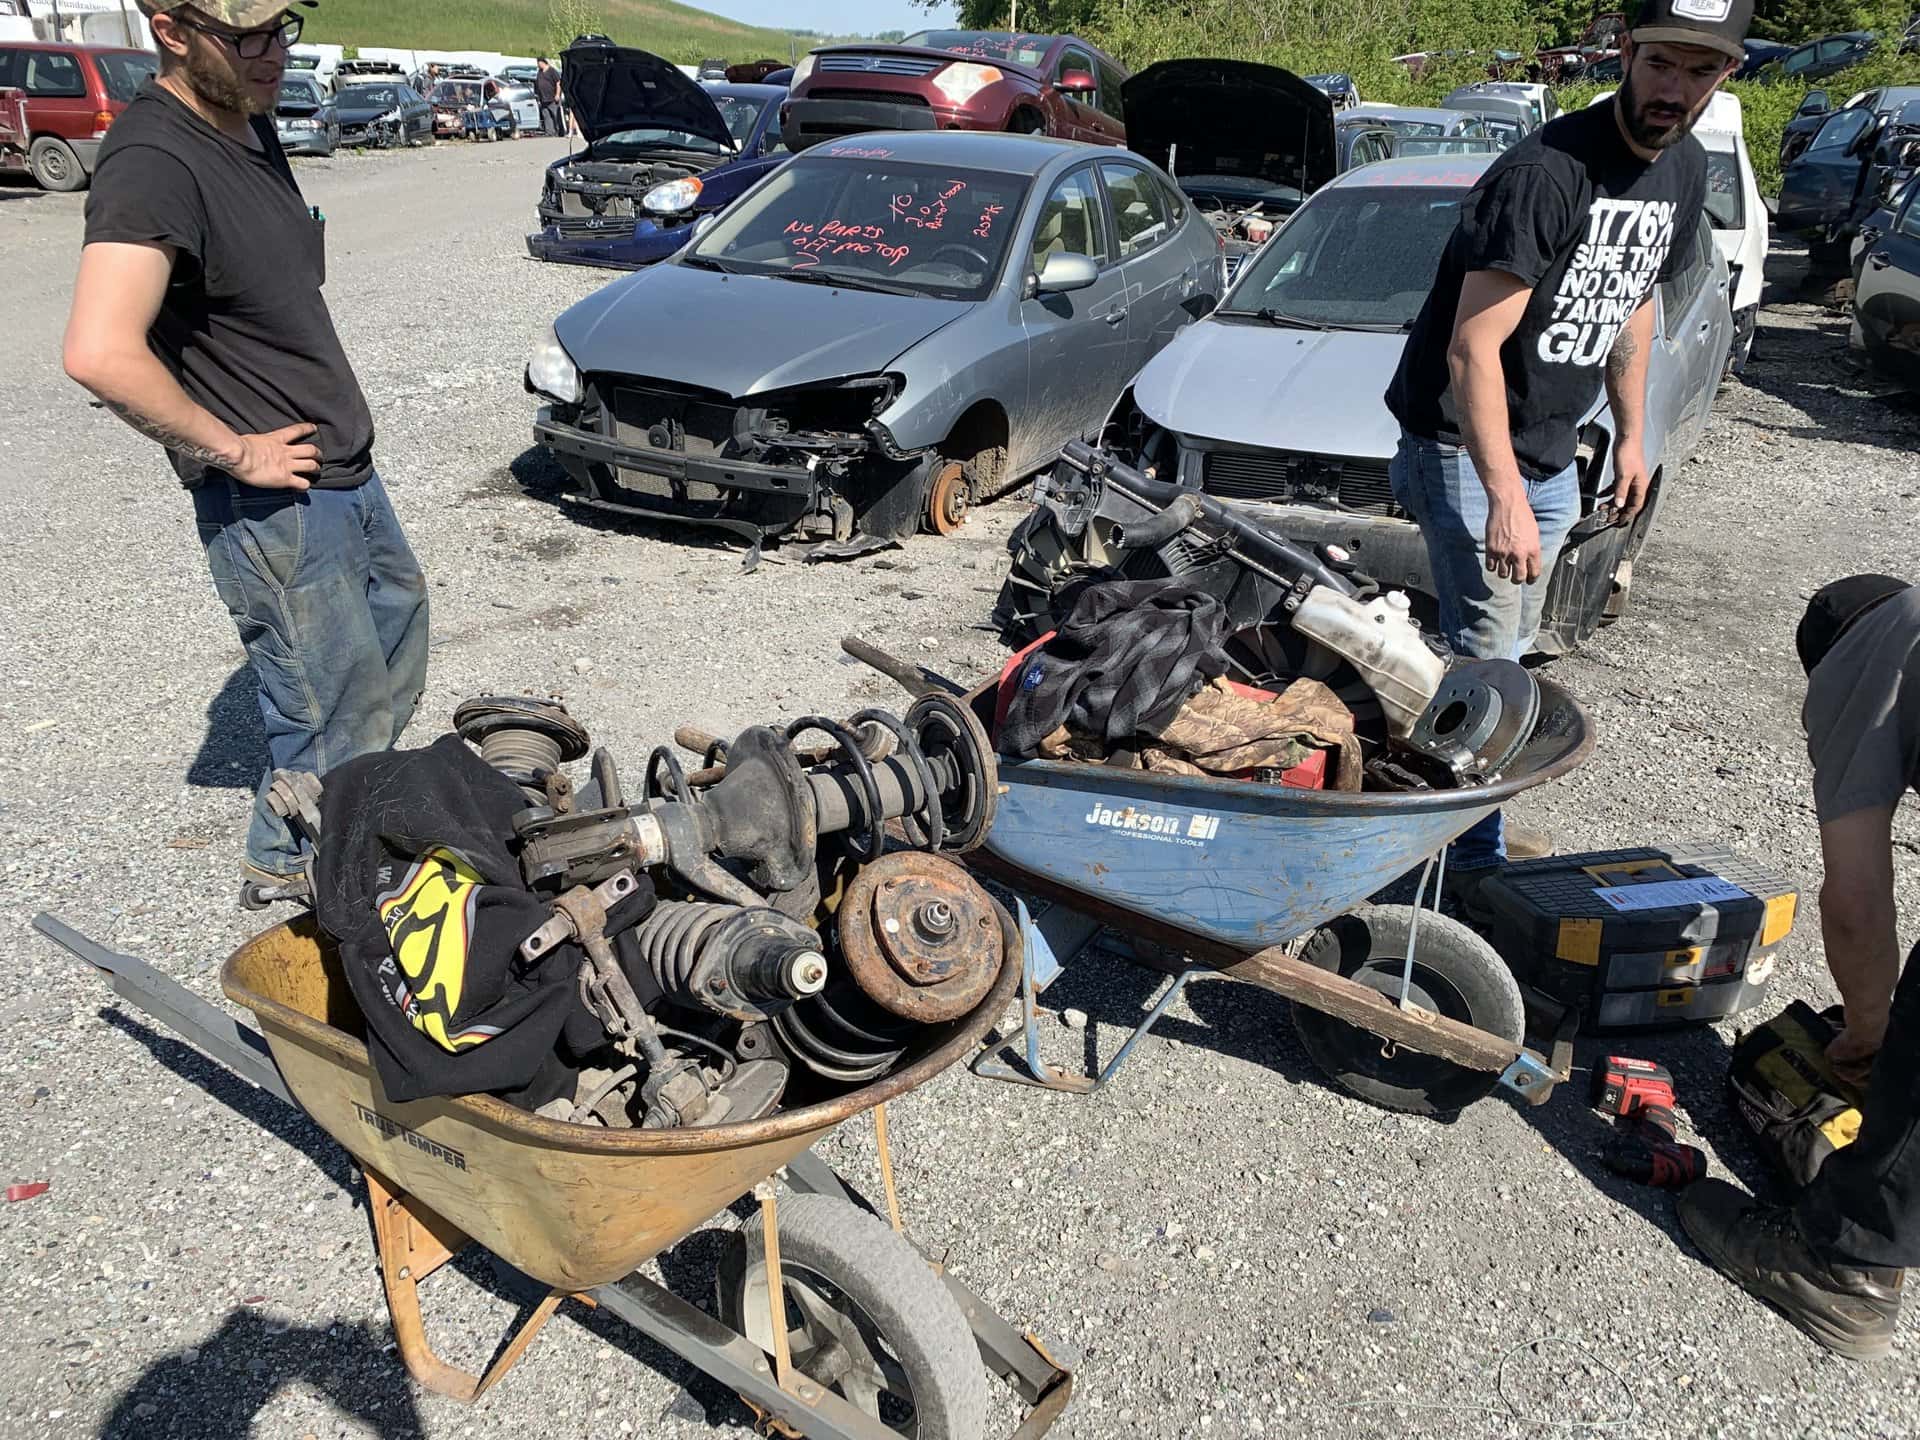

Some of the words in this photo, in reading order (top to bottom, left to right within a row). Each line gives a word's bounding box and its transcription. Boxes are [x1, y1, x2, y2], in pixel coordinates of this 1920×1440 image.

[1571, 243, 1626, 271] SURE
[1558, 268, 1602, 298] NO
[1603, 270, 1651, 299] ONE
[1176, 837, 1204, 847] TOOLS
[351, 1100, 397, 1137] TRUE
[400, 1125, 467, 1172] TEMPER
